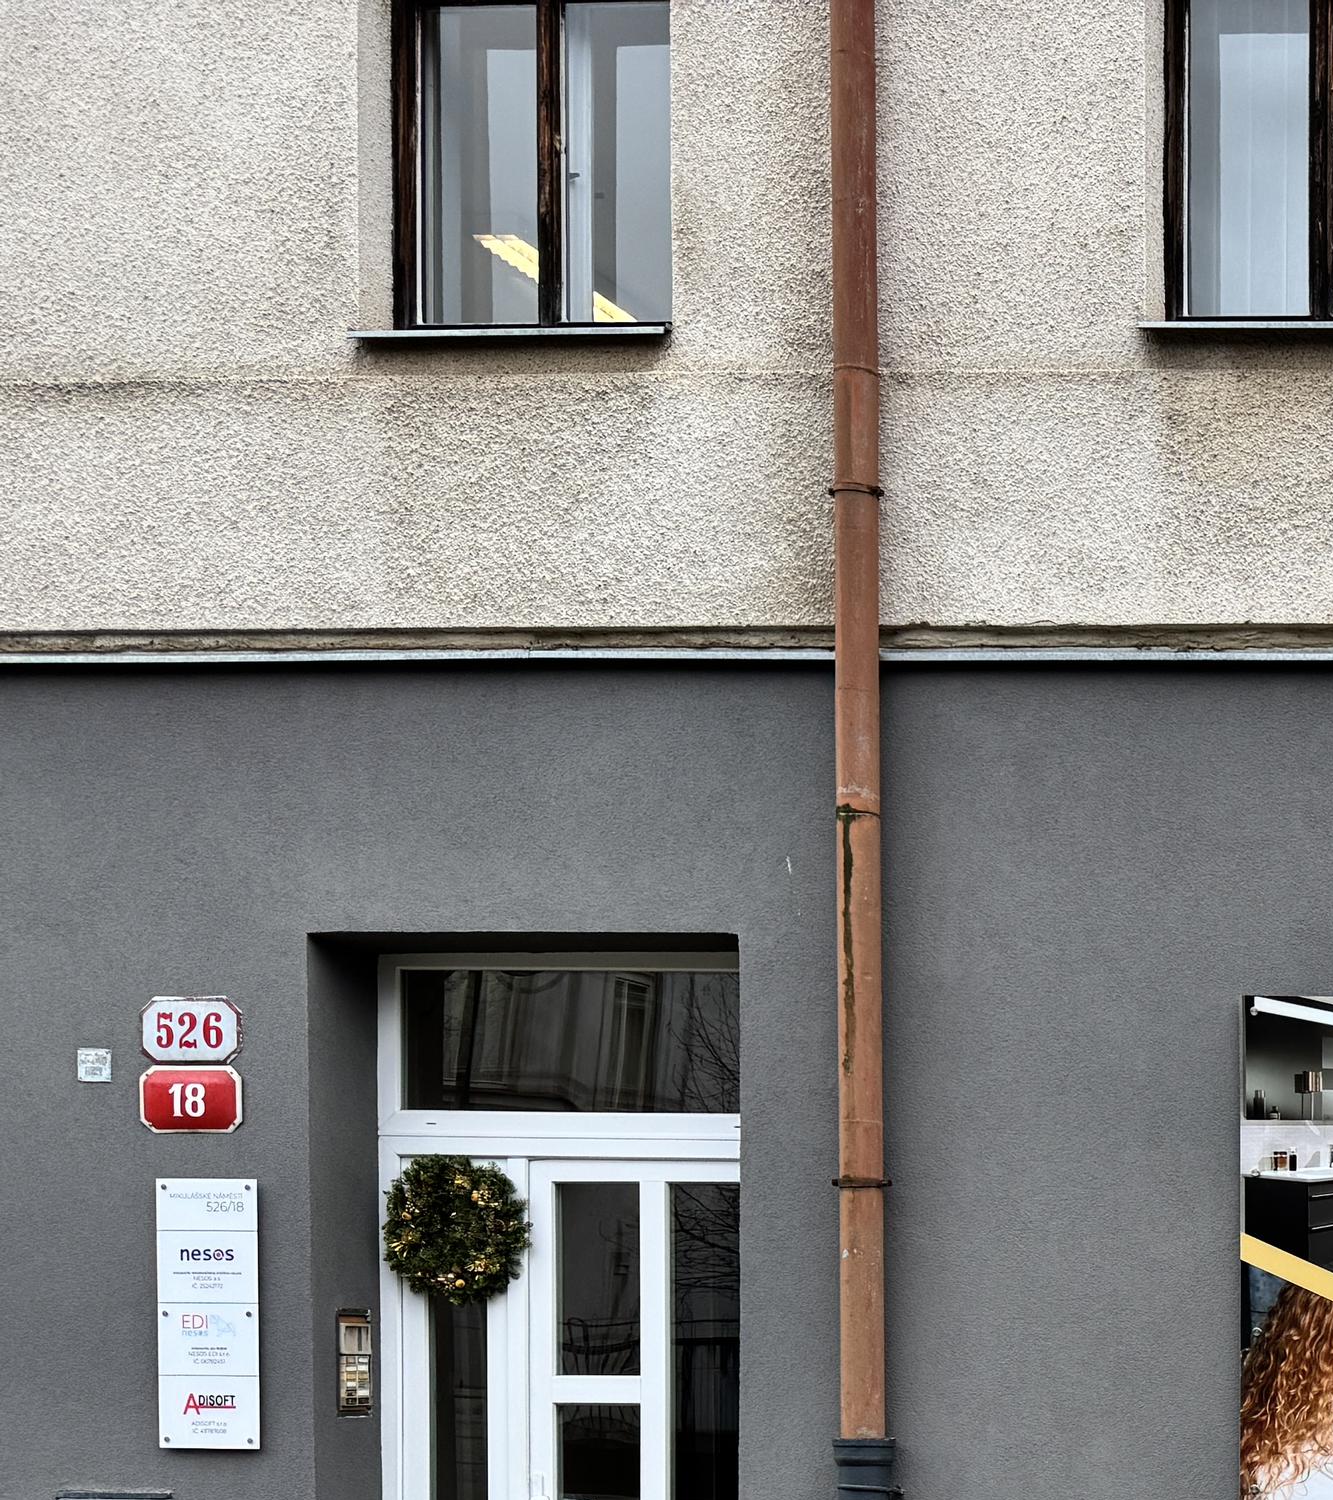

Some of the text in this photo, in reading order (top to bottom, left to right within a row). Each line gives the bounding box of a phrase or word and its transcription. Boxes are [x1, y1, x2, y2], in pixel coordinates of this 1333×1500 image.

[156, 1012, 224, 1049] 526
[168, 1083, 206, 1118] 18
[206, 1201, 245, 1213] 526/18
[180, 1248, 235, 1262] nesos
[181, 1314, 208, 1330] EDI
[183, 1393, 237, 1415] ADISOFT
